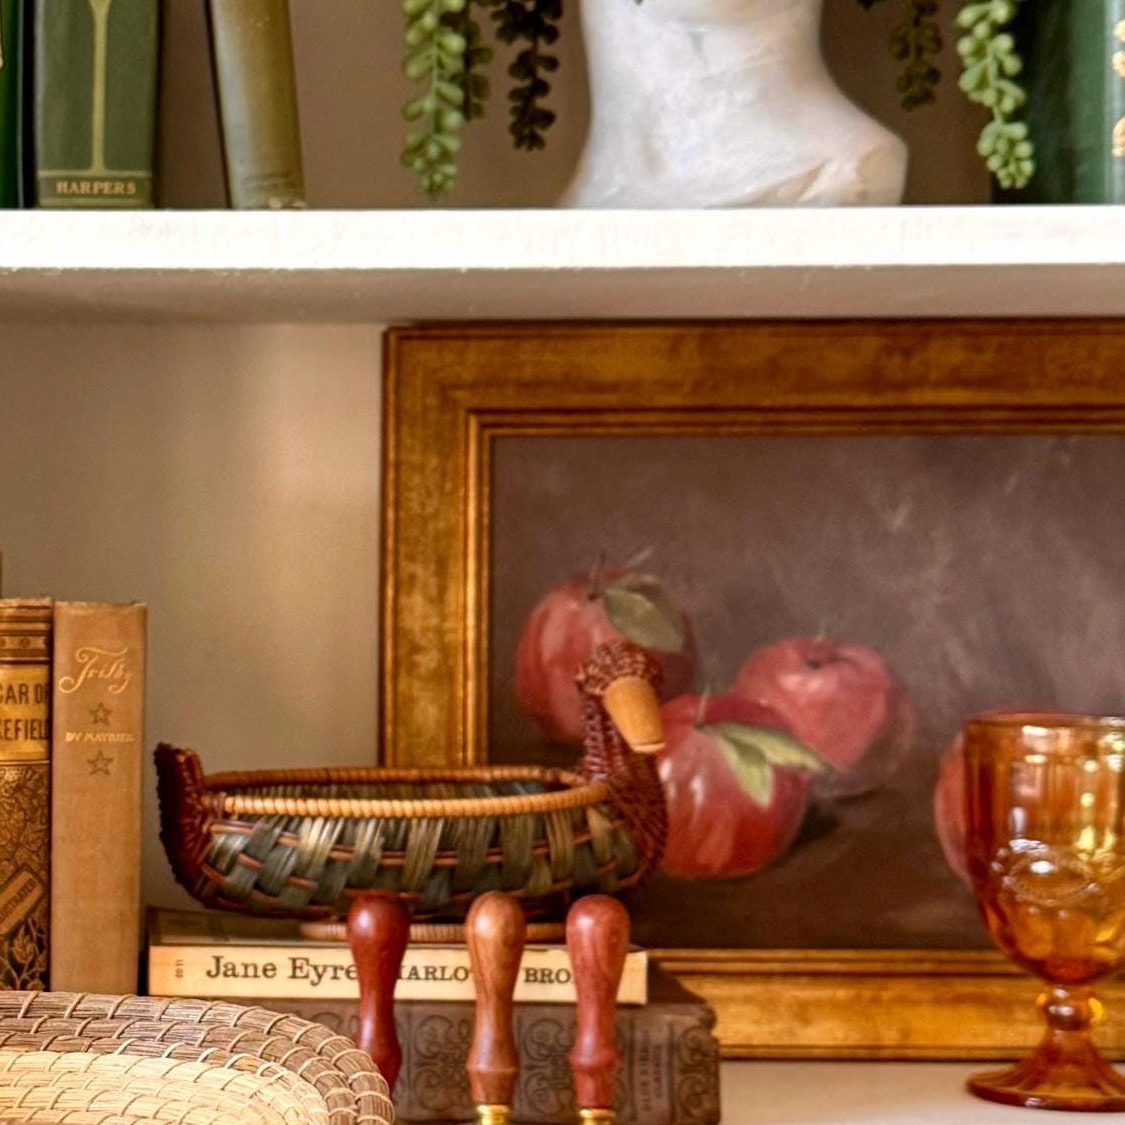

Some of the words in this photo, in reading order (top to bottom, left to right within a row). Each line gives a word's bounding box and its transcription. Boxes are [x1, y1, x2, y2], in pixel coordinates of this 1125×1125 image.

[56, 181, 137, 195] HARPERS
[58, 647, 132, 694] Trilby
[206, 956, 278, 980] Jane
[288, 957, 360, 987] Eyre
[525, 968, 573, 984] BRO
